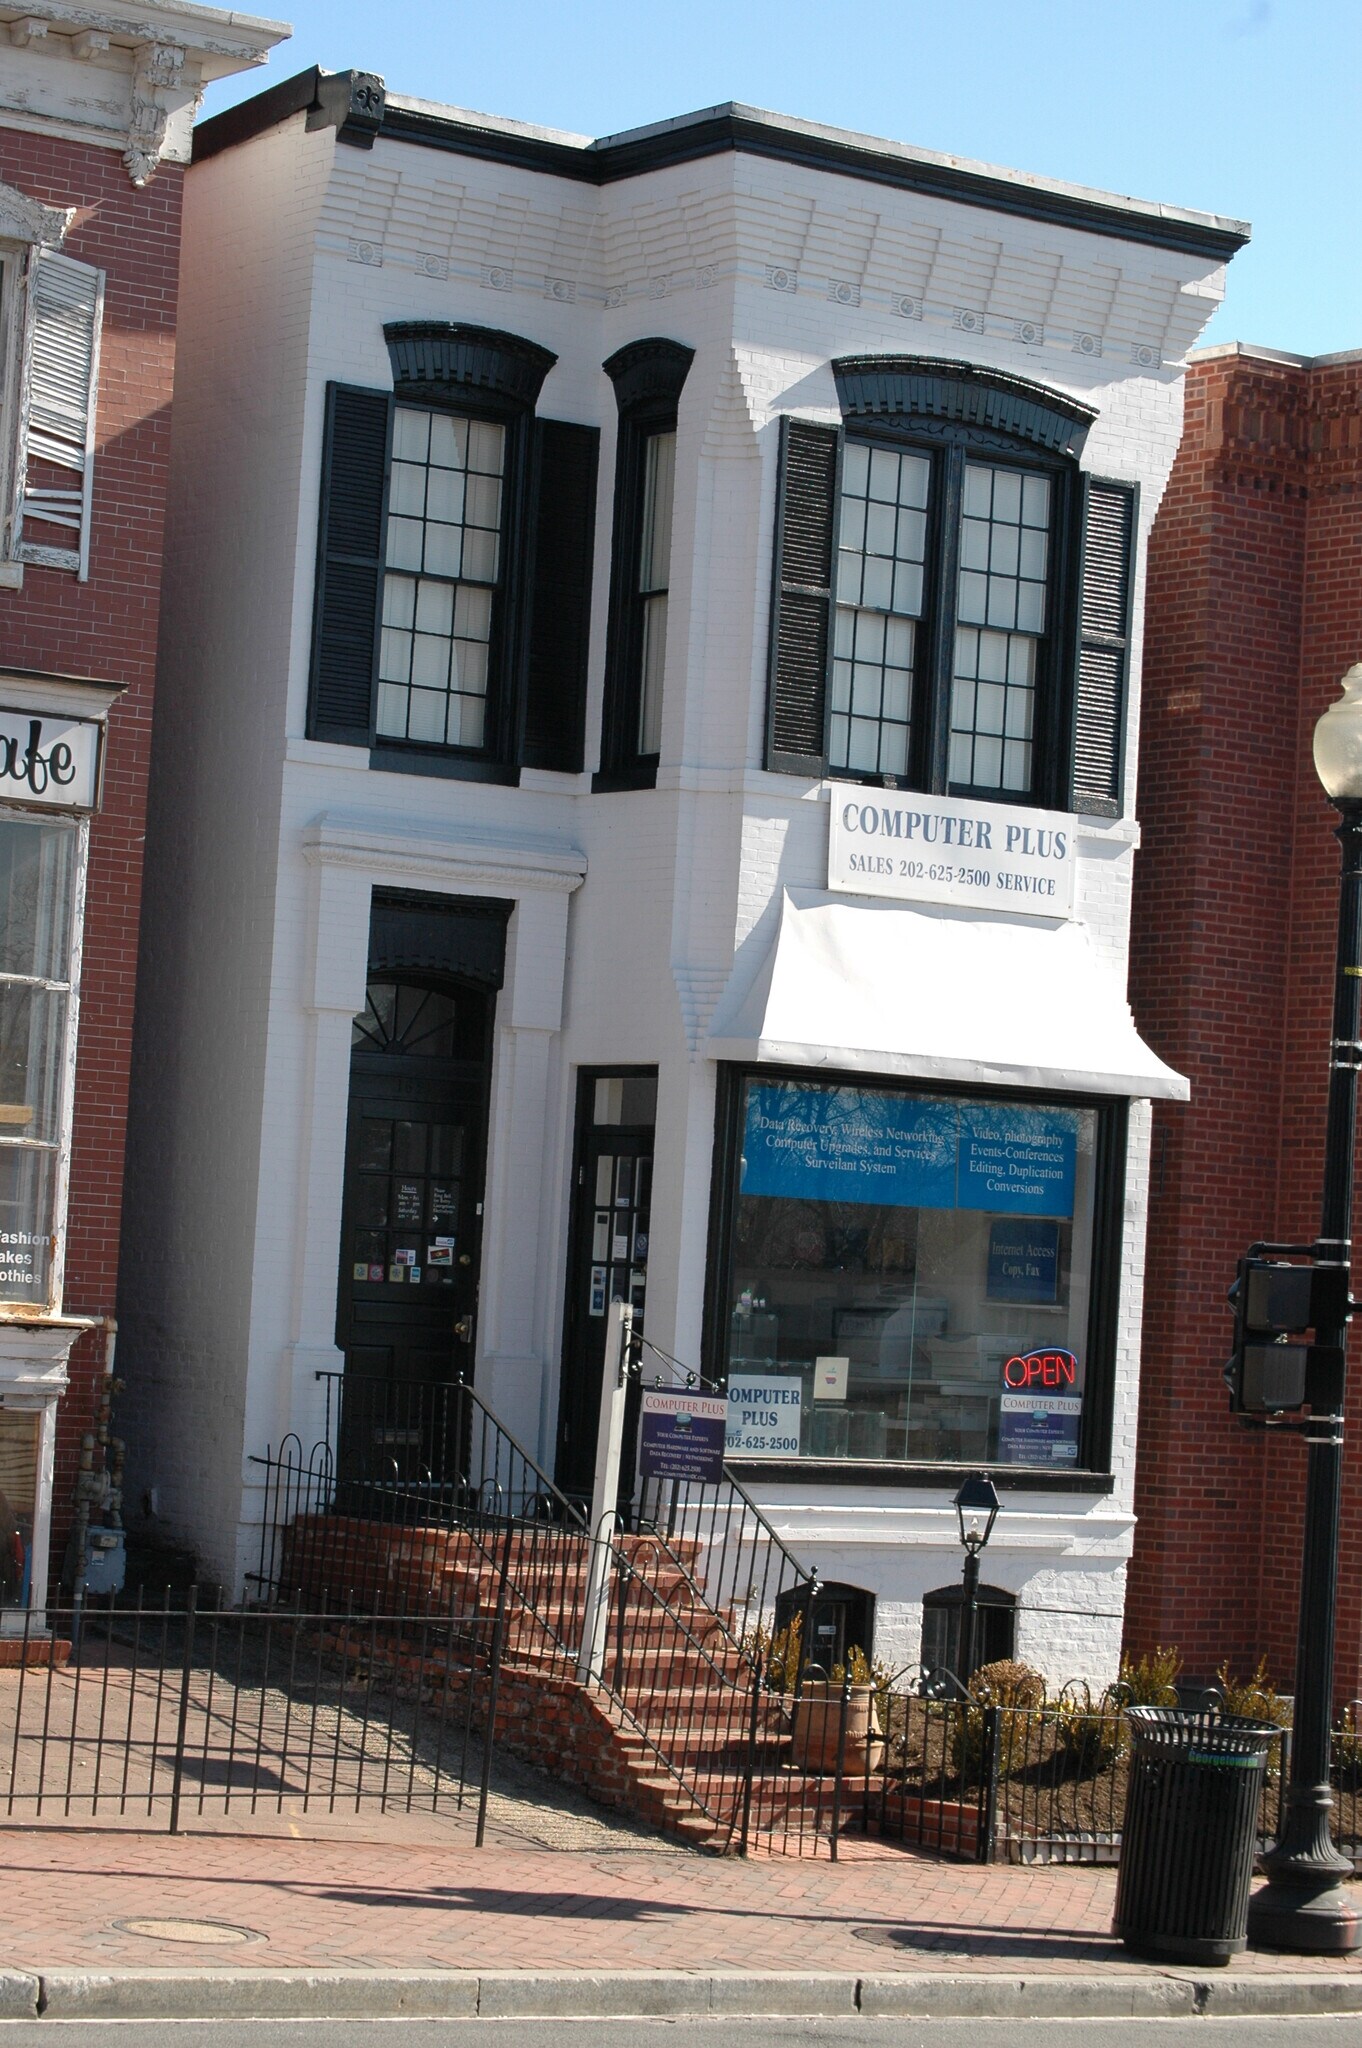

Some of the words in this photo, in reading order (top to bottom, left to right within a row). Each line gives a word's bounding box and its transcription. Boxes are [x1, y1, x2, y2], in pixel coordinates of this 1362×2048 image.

[842, 803, 992, 850] COMPUTER
[1005, 824, 1067, 860] PLUS
[849, 853, 893, 875] SALES
[899, 860, 990, 887] 202-625-2500
[996, 872, 1056, 896] SERVICE
[760, 1116, 784, 1130] Data
[841, 1123, 883, 1138] Wireless
[886, 1127, 945, 1146] Networking
[1004, 1130, 1064, 1149] photography
[766, 1135, 817, 1151] Computer
[873, 1145, 892, 1157] and
[894, 1145, 937, 1162] Services
[971, 1143, 1064, 1163] Events-Conferences
[859, 1161, 896, 1175] System
[1009, 1164, 1064, 1180] Duplication
[986, 1178, 1044, 1195] Conversions
[992, 1241, 1024, 1256] Internet
[1025, 1244, 1055, 1258] Access
[1025, 1263, 1040, 1277] Fax
[1005, 1355, 1075, 1386] OPEN
[645, 1396, 698, 1412] COMPUTER
[702, 1402, 724, 1415] PLUS
[727, 1388, 801, 1405] OMPUTER
[1003, 1398, 1054, 1410] COMPUTER
[1057, 1400, 1080, 1411] PLUS
[741, 1410, 778, 1427] PLUS
